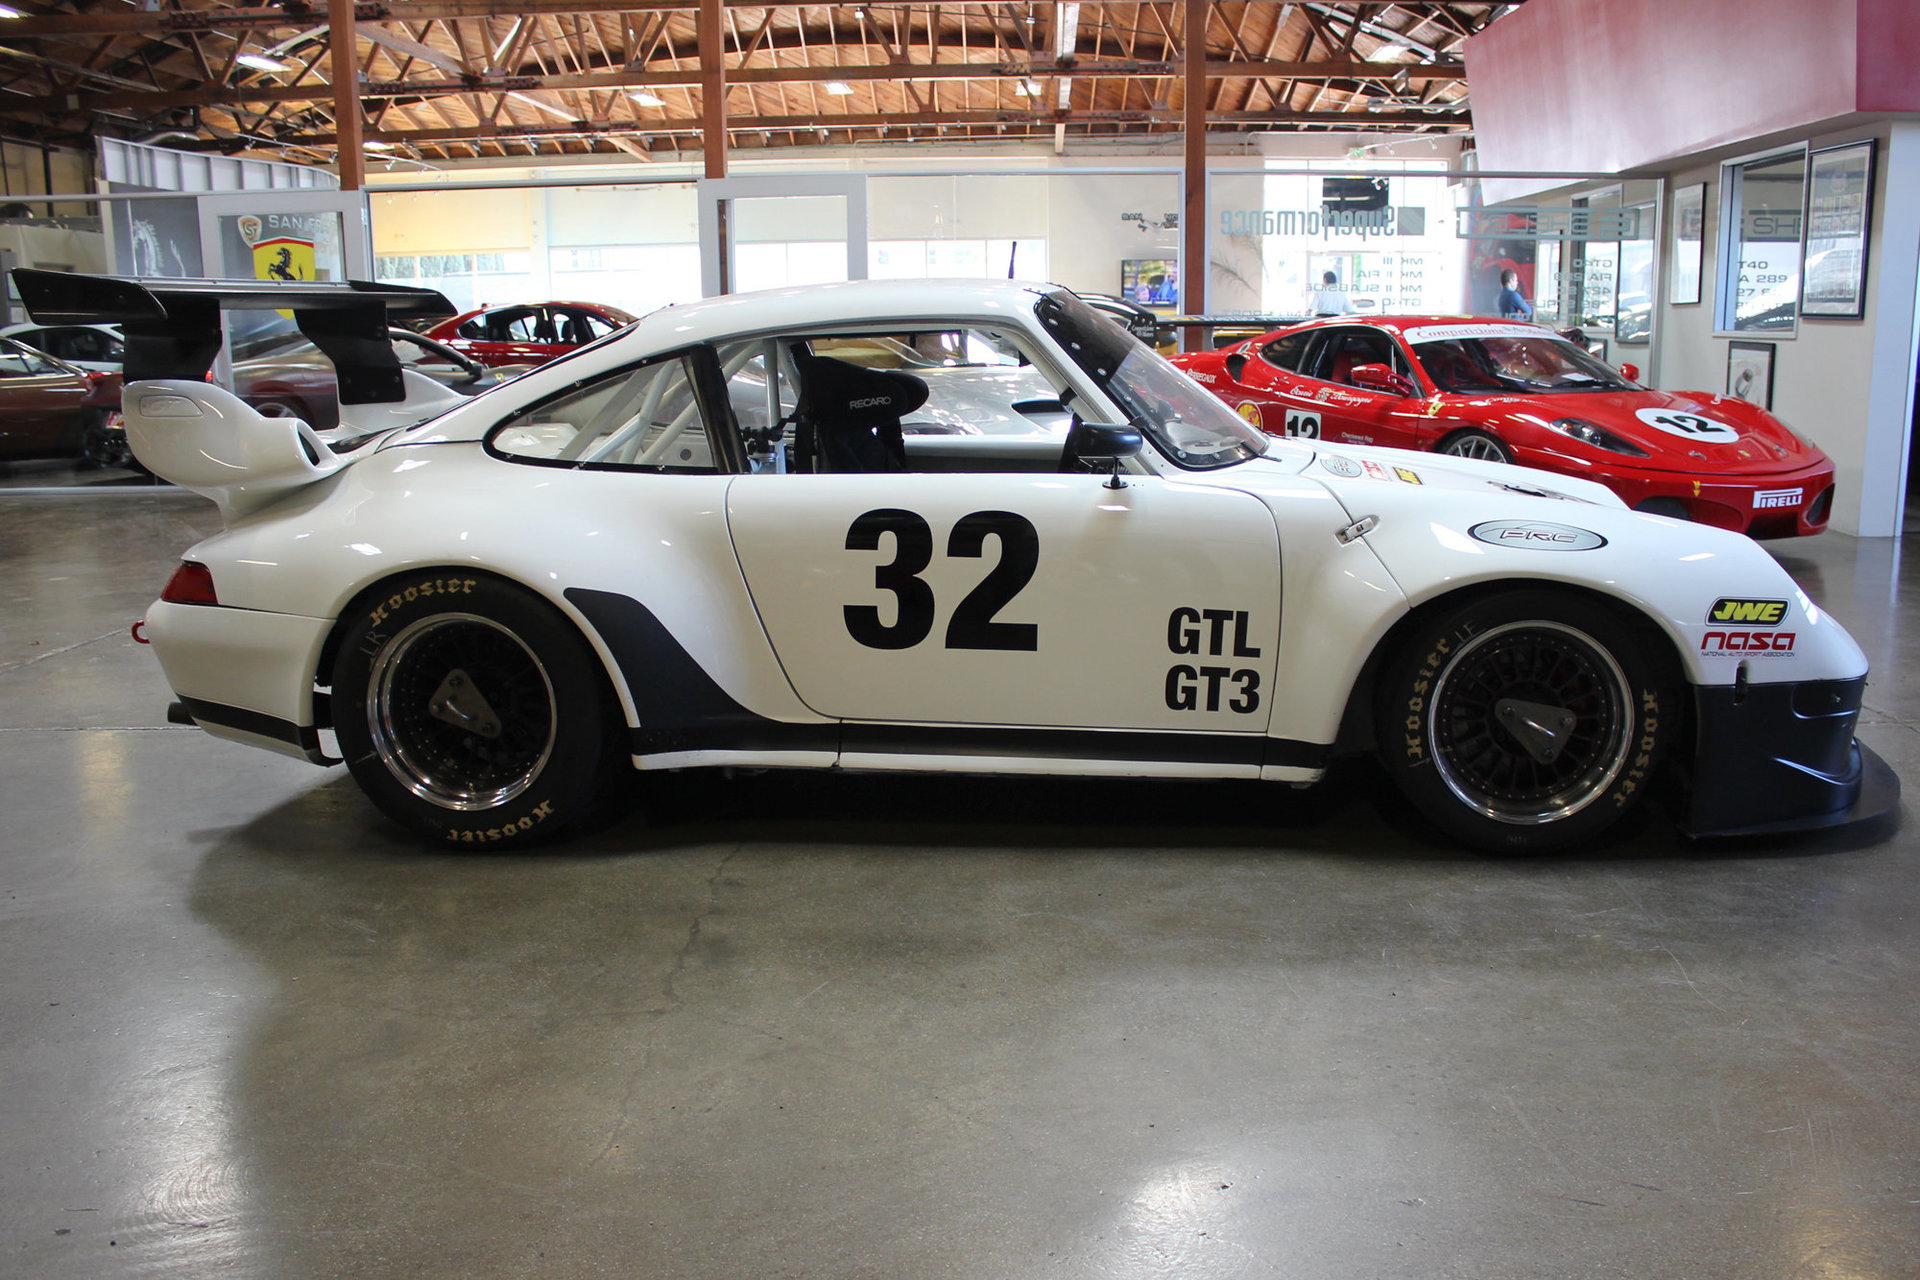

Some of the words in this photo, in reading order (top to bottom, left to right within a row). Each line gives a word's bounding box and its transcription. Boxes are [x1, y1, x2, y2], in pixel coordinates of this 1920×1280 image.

[268, 214, 303, 229] SAN
[849, 396, 892, 410] RECARO
[1286, 415, 1320, 440] 12
[1654, 415, 1727, 433] 12
[1752, 488, 1803, 509] PIRELLI
[843, 508, 1040, 651] 32
[1713, 601, 1785, 622] JWE
[1167, 606, 1261, 658] GTL
[1165, 664, 1261, 714] GT3
